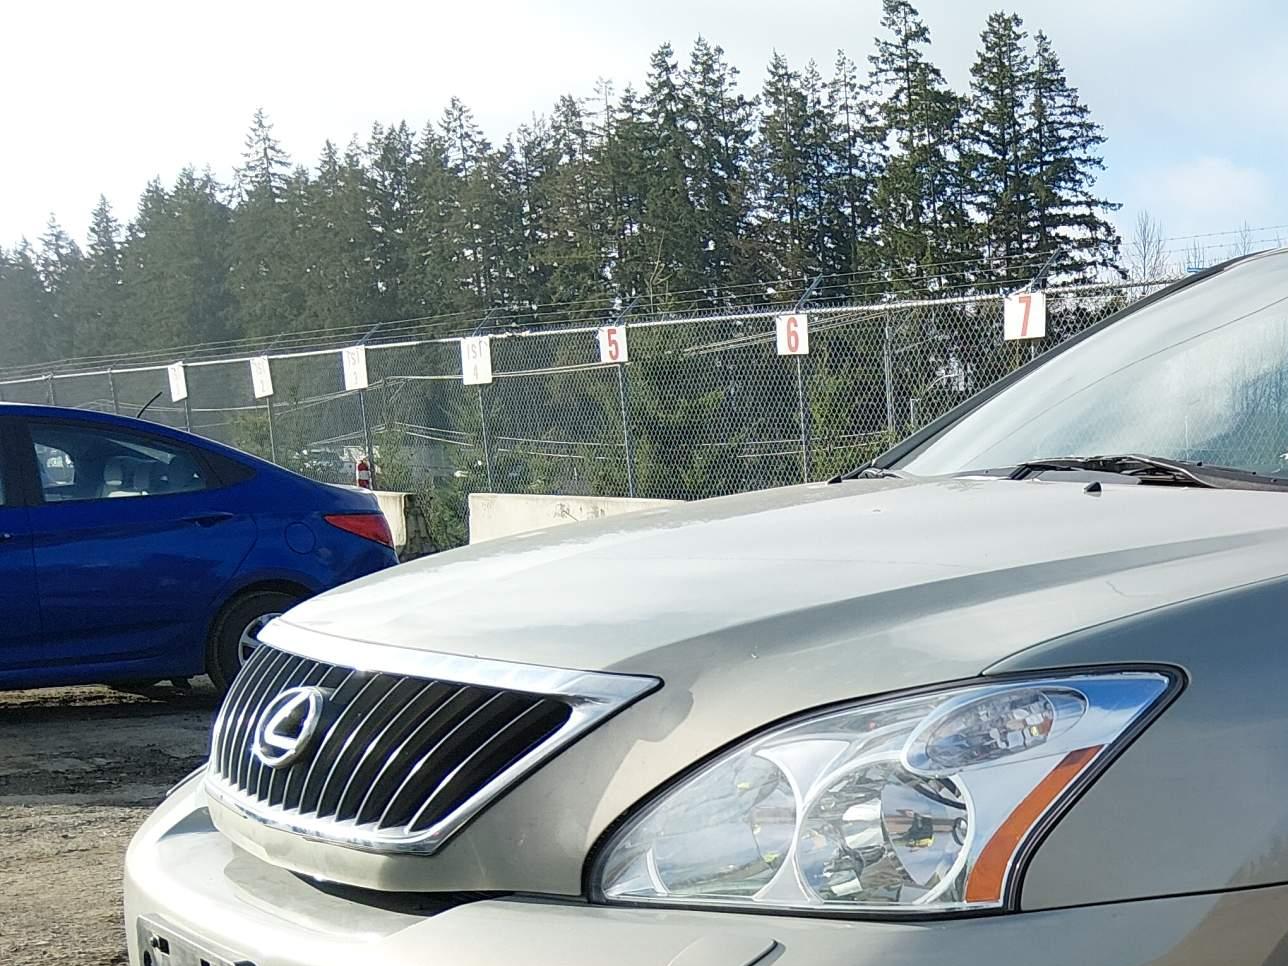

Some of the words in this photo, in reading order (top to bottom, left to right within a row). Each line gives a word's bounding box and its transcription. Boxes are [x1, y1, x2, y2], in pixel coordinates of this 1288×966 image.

[786, 316, 799, 353] 6
[1018, 296, 1032, 336] 7
[607, 328, 619, 361] 5
